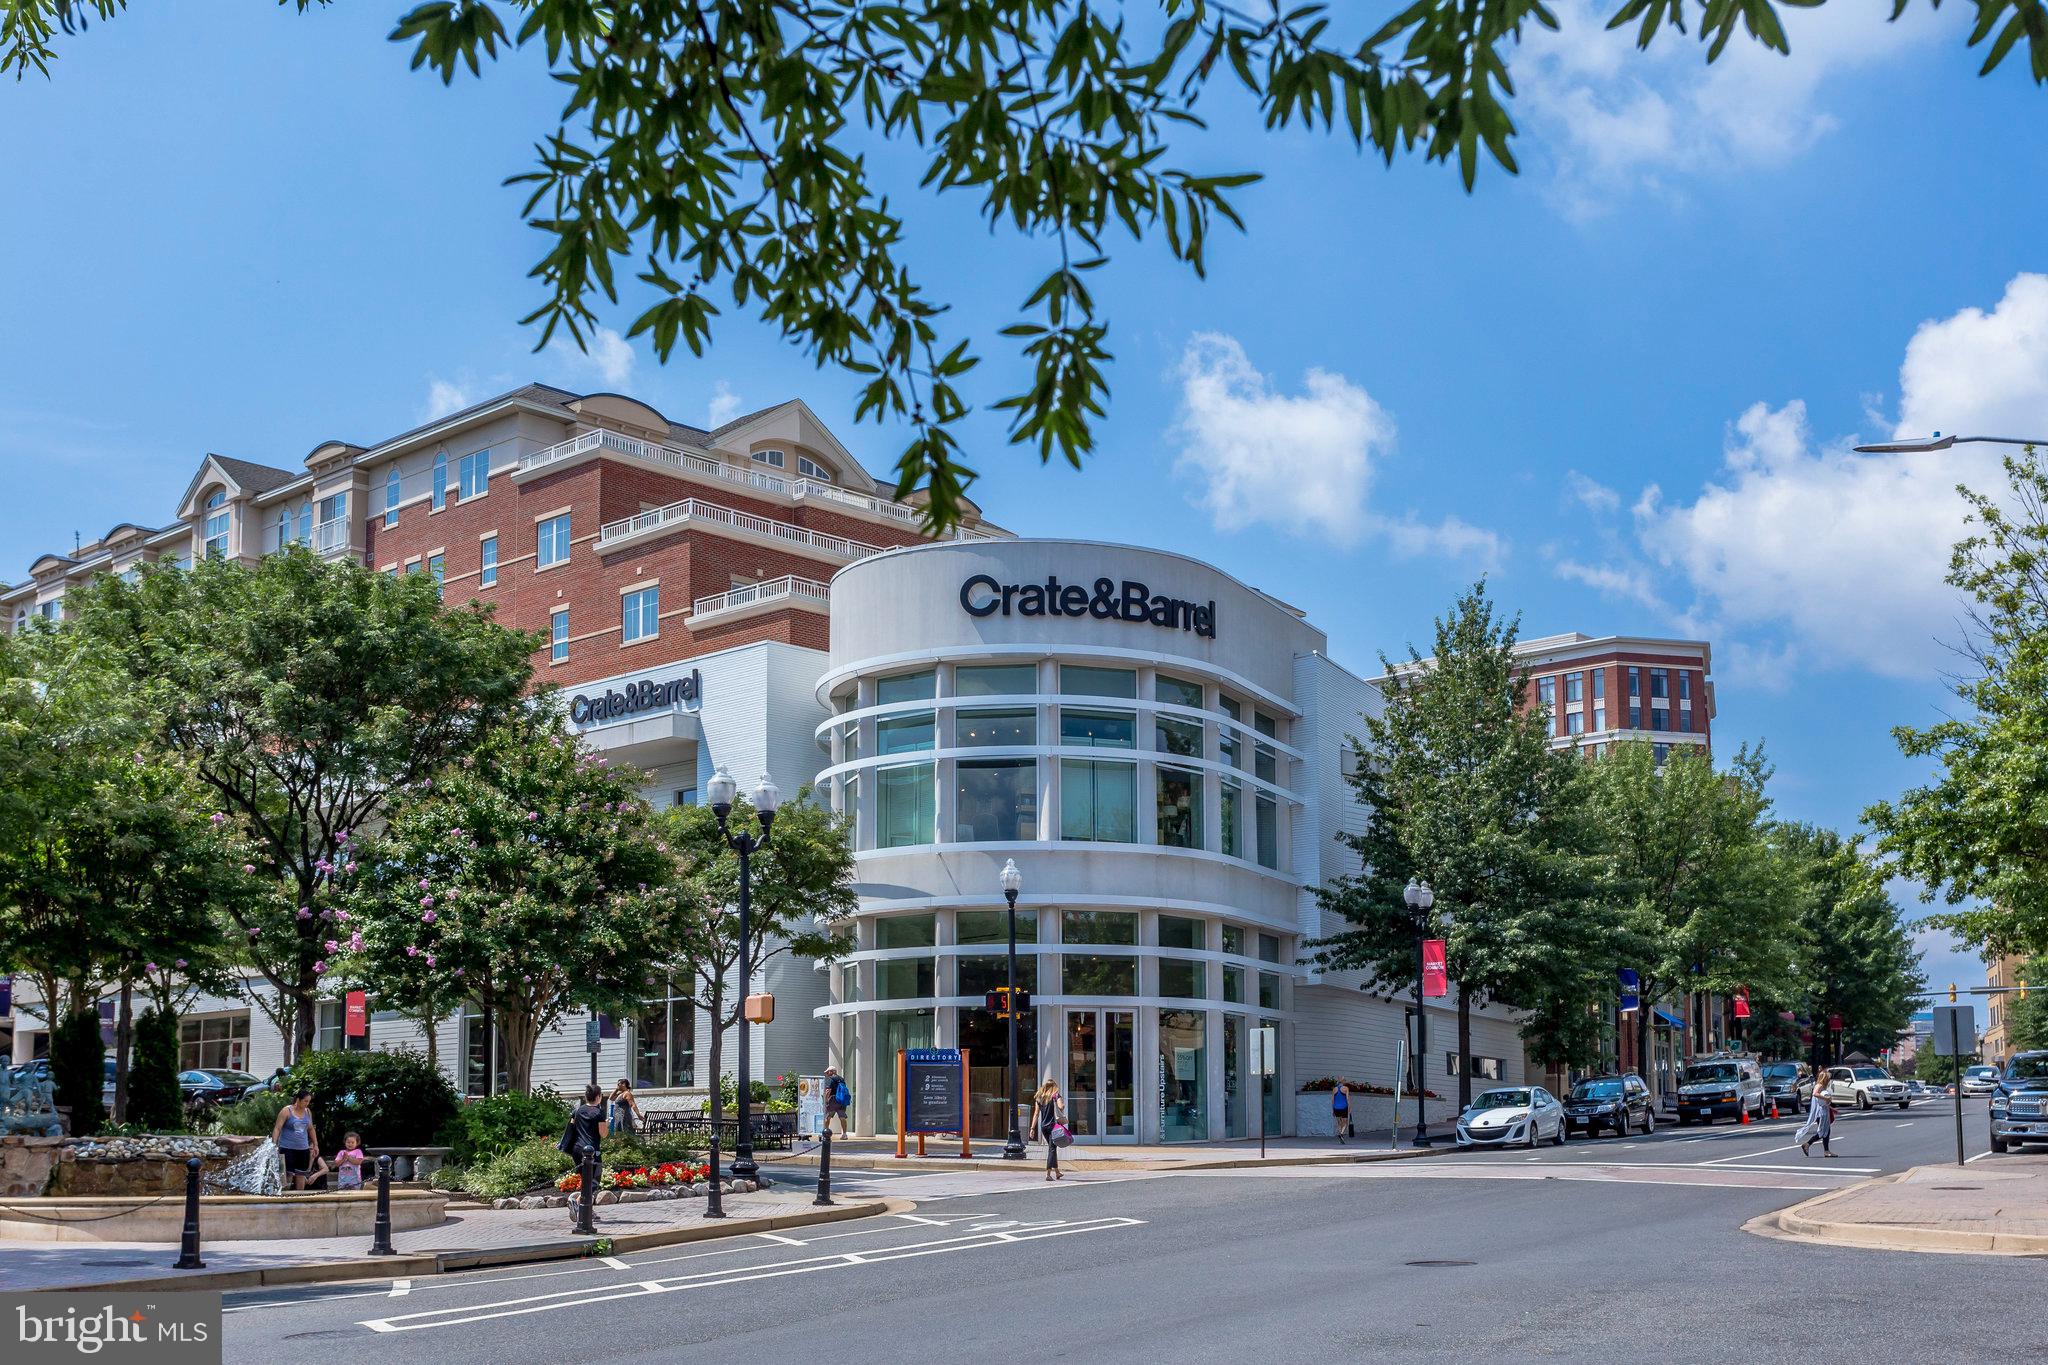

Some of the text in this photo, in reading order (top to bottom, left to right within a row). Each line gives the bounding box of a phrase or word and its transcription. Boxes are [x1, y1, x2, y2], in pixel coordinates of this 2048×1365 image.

[960, 574, 1216, 640] Crate&Barrel
[570, 668, 699, 724] Crate&Barrel
[1001, 995, 1007, 1009] 5
